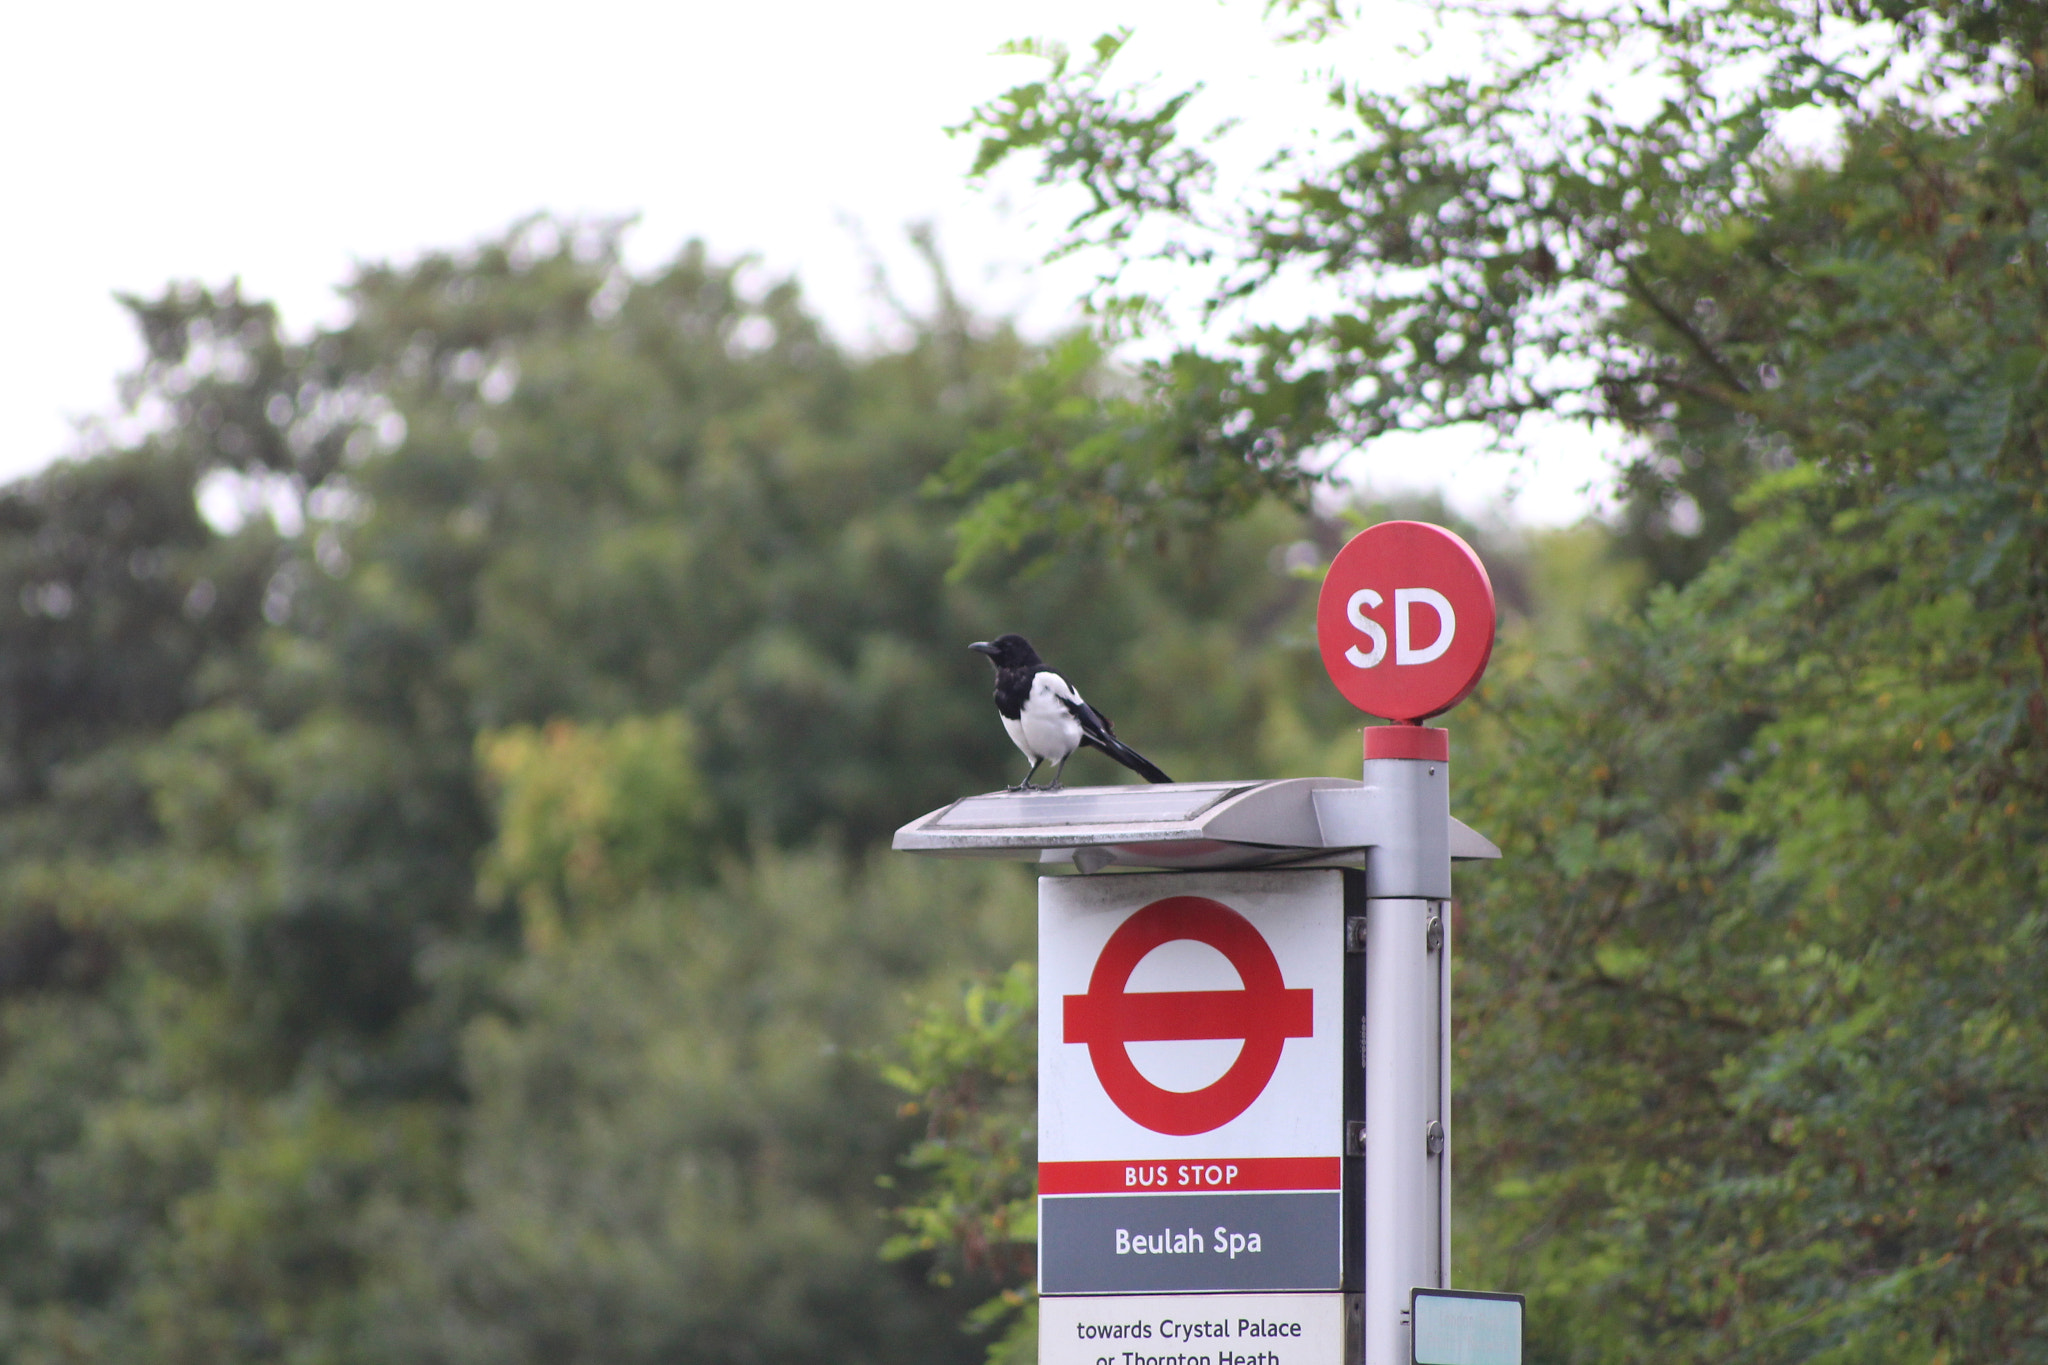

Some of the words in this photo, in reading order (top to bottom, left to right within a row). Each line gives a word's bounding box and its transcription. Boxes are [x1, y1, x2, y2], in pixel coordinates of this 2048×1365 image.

[1344, 587, 1456, 669] SD
[1125, 1165, 1168, 1187] BUS
[1178, 1165, 1238, 1186] STOP
[1115, 1227, 1204, 1255] Beulah
[1213, 1226, 1262, 1260] Spa
[1076, 1319, 1152, 1340] towards
[1159, 1318, 1230, 1343] Crystal
[1238, 1318, 1302, 1338] Palace
